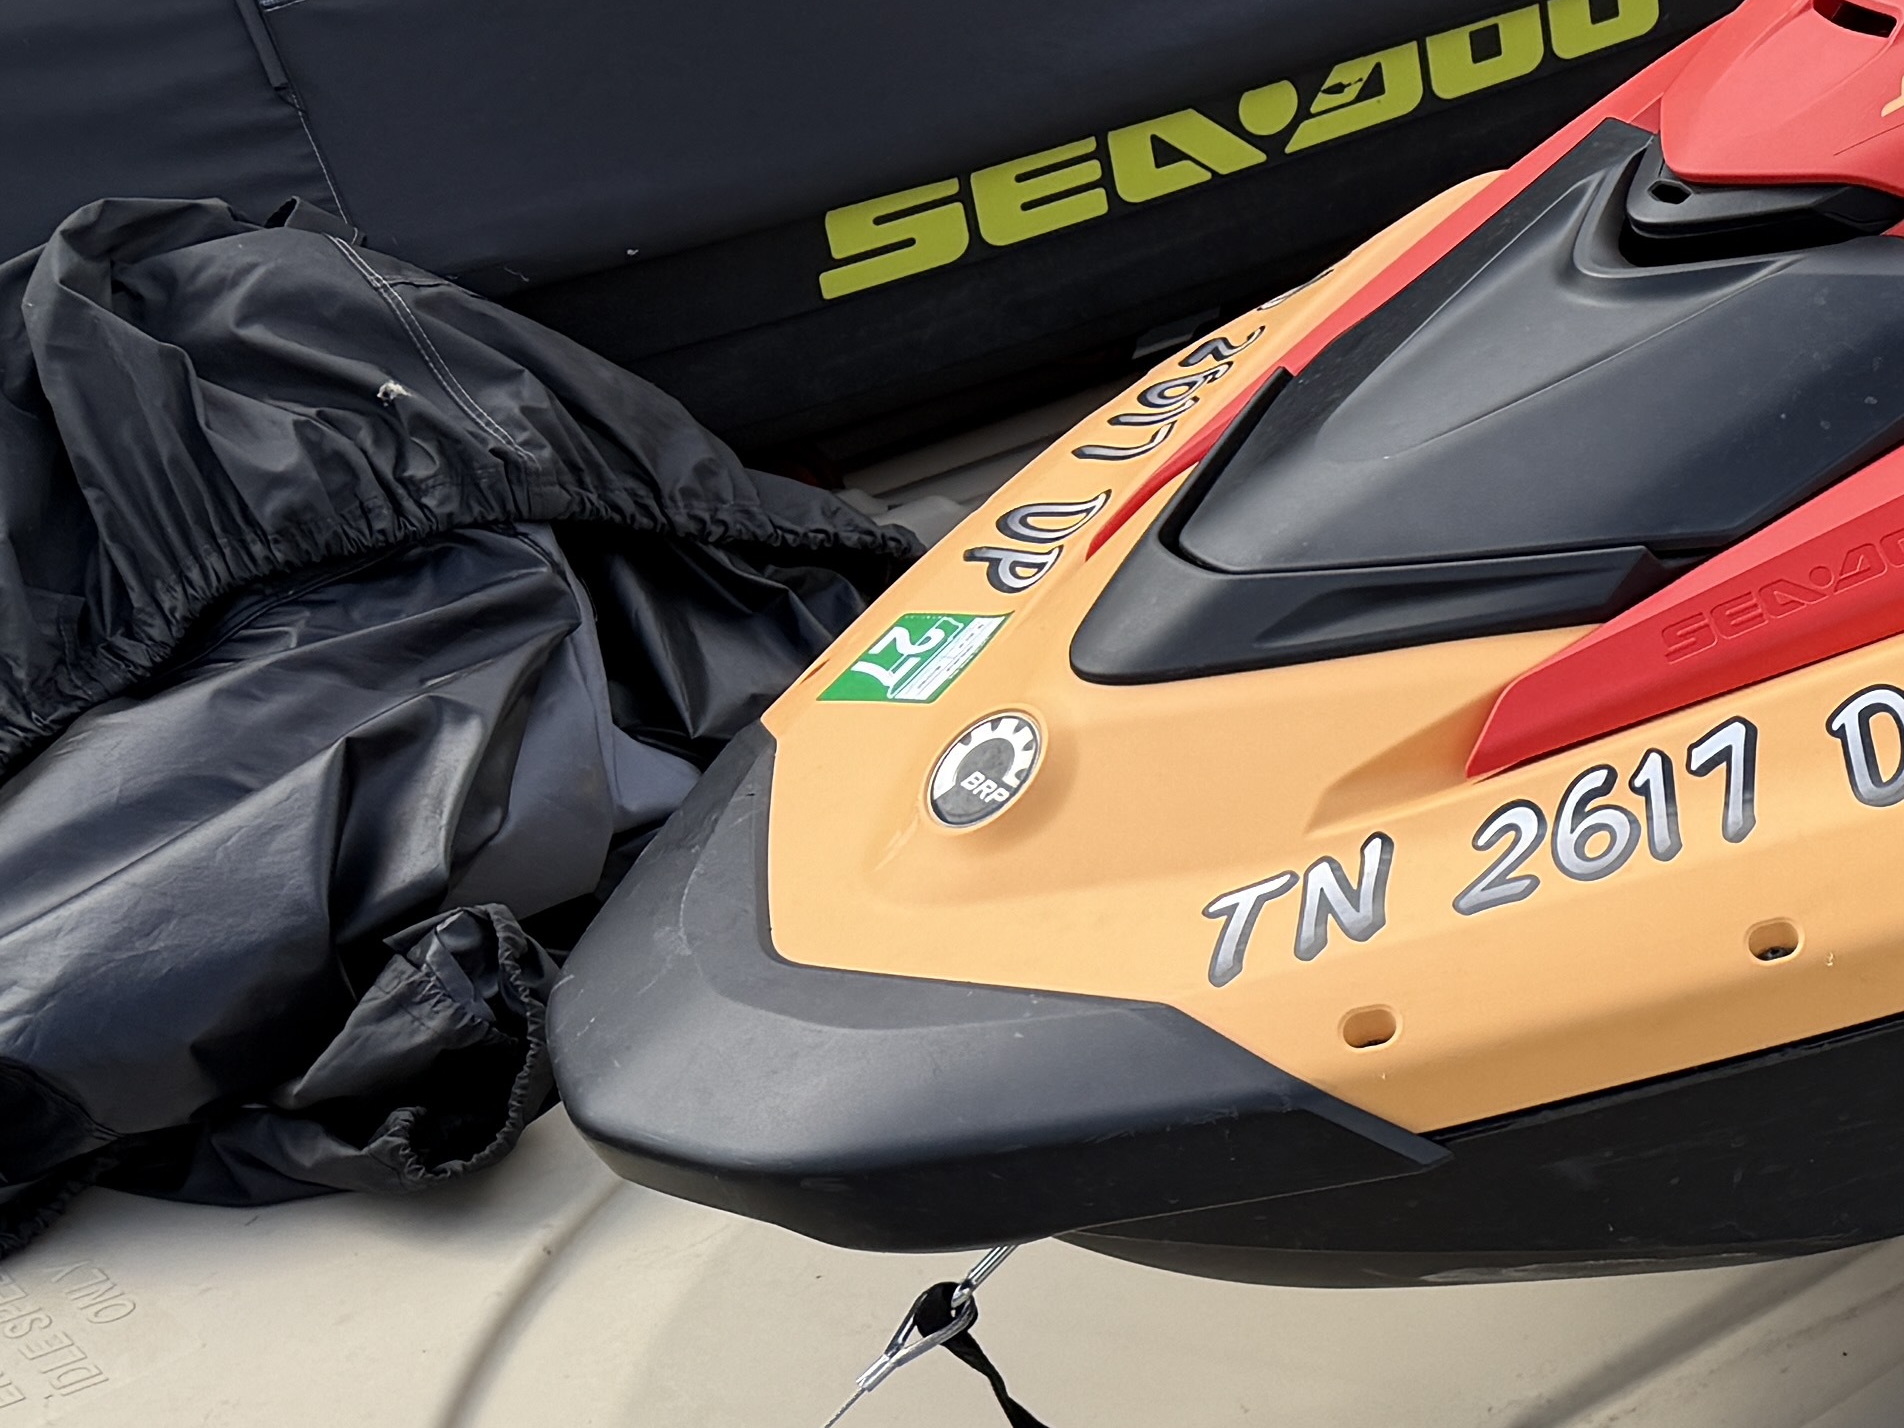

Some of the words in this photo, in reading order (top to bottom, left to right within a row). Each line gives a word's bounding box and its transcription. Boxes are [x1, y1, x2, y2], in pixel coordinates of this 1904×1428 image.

[962, 488, 1113, 594] DP
[850, 625, 946, 687] 27
[959, 770, 1010, 804] BRP
[1203, 831, 1395, 989] TN
[1451, 716, 1760, 920] 2617
